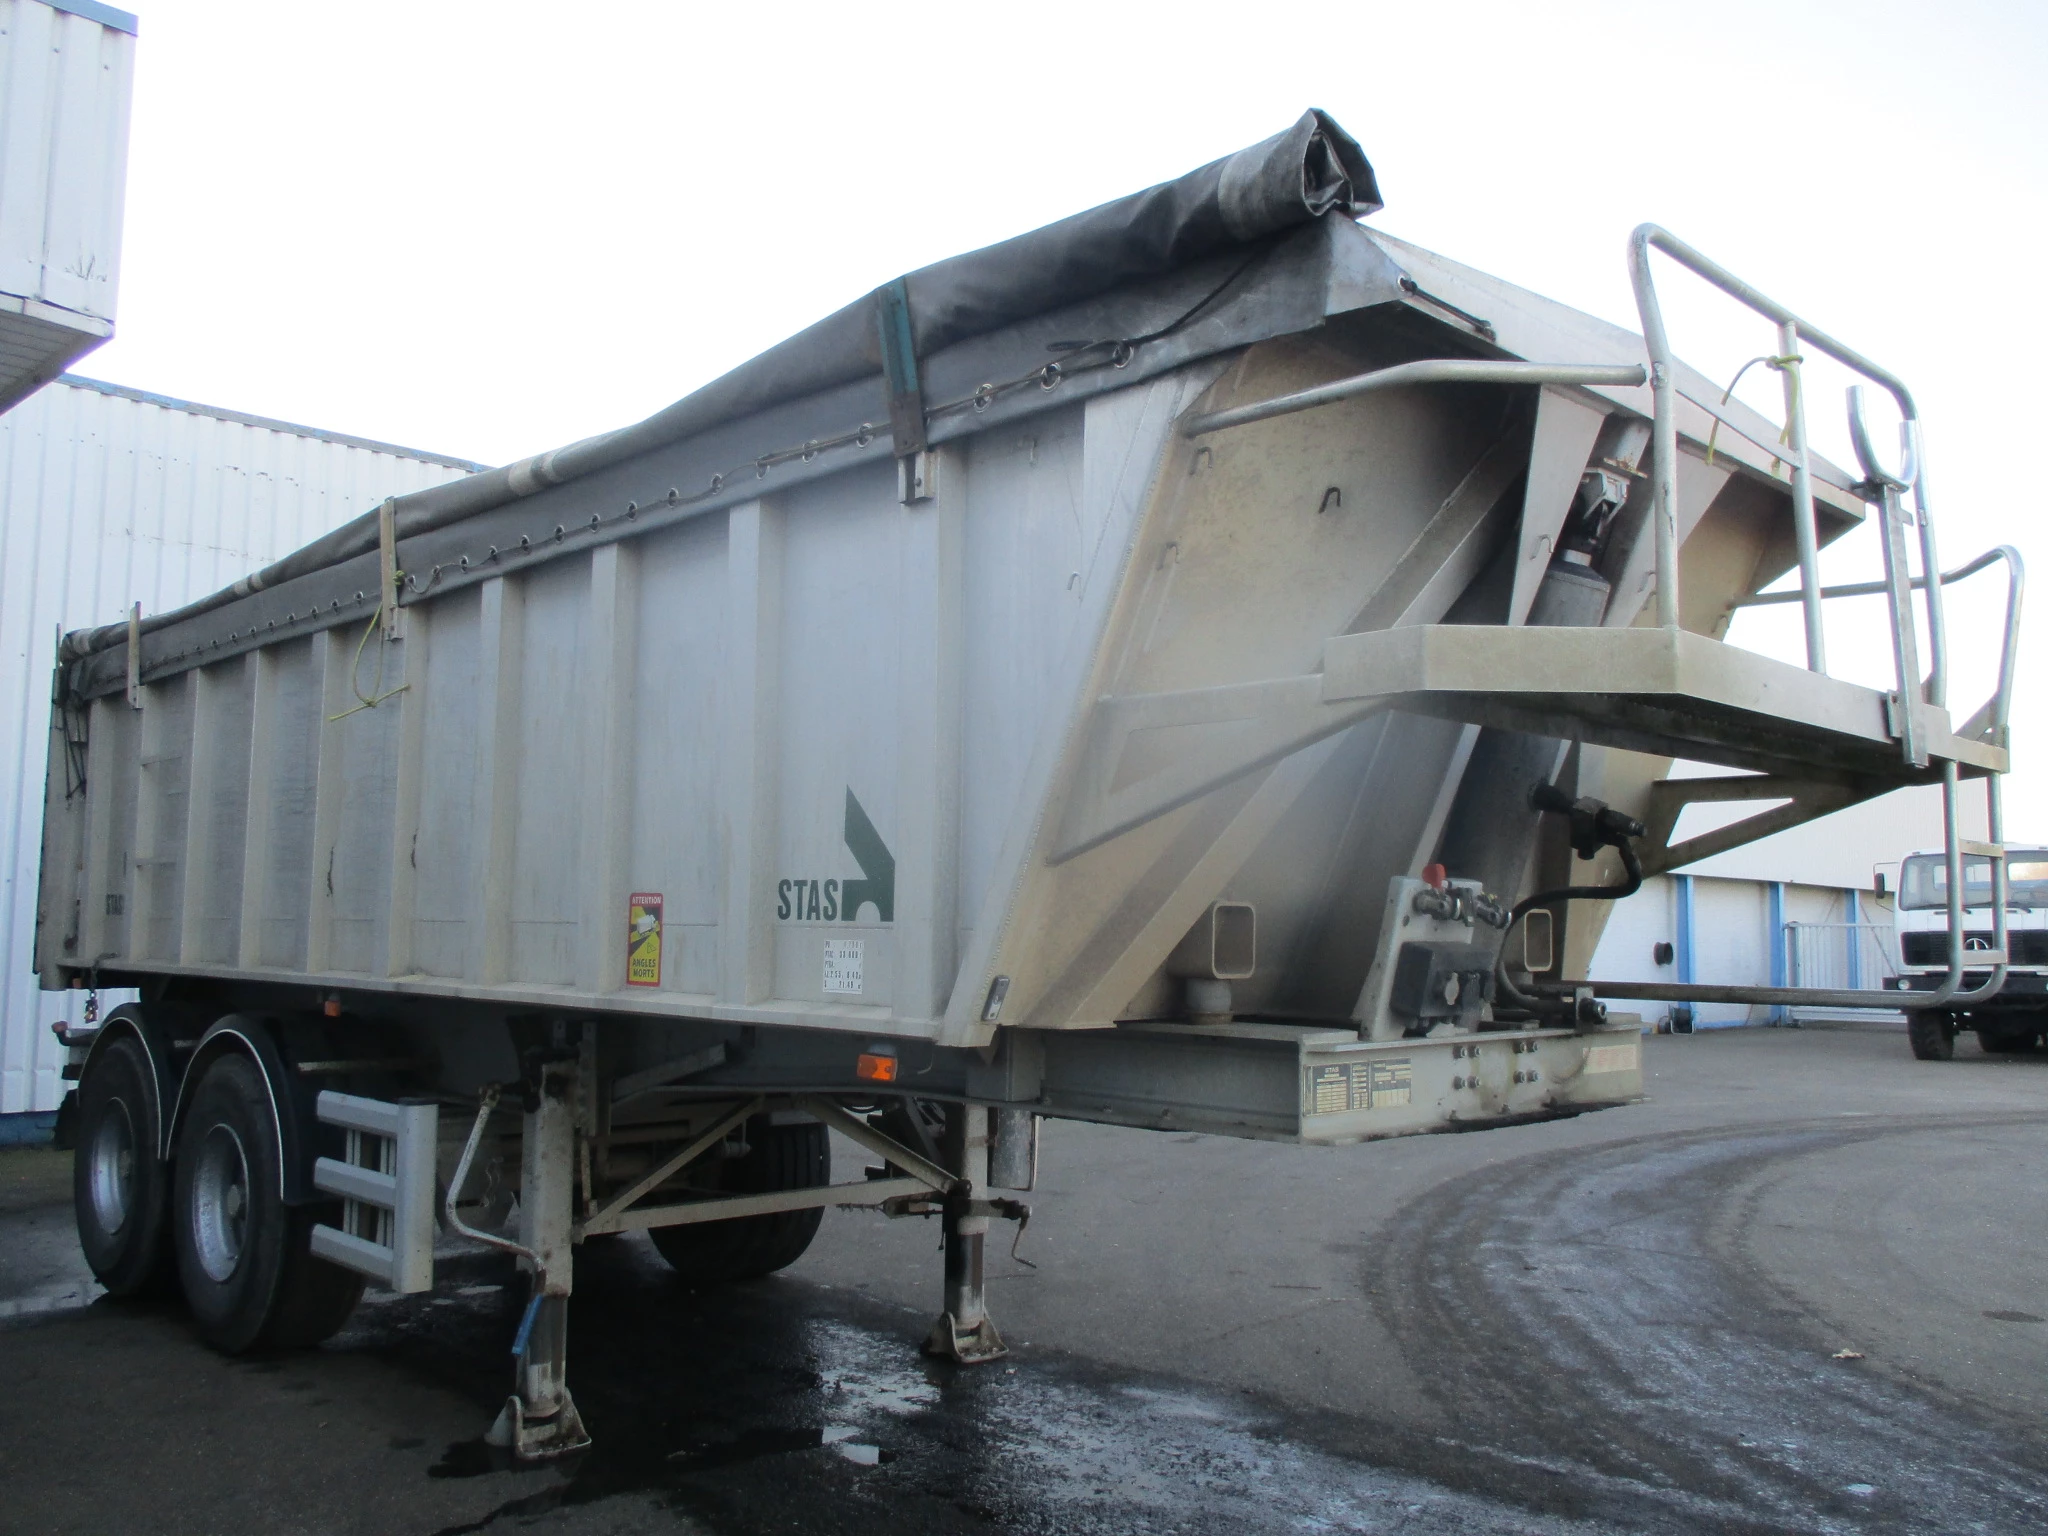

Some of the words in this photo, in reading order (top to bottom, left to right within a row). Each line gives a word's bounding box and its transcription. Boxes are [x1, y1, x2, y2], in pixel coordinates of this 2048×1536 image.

[631, 896, 661, 905] ATTENTION
[777, 878, 839, 921] STAS
[632, 958, 656, 968] ANGLES
[633, 968, 655, 978] MORTS
